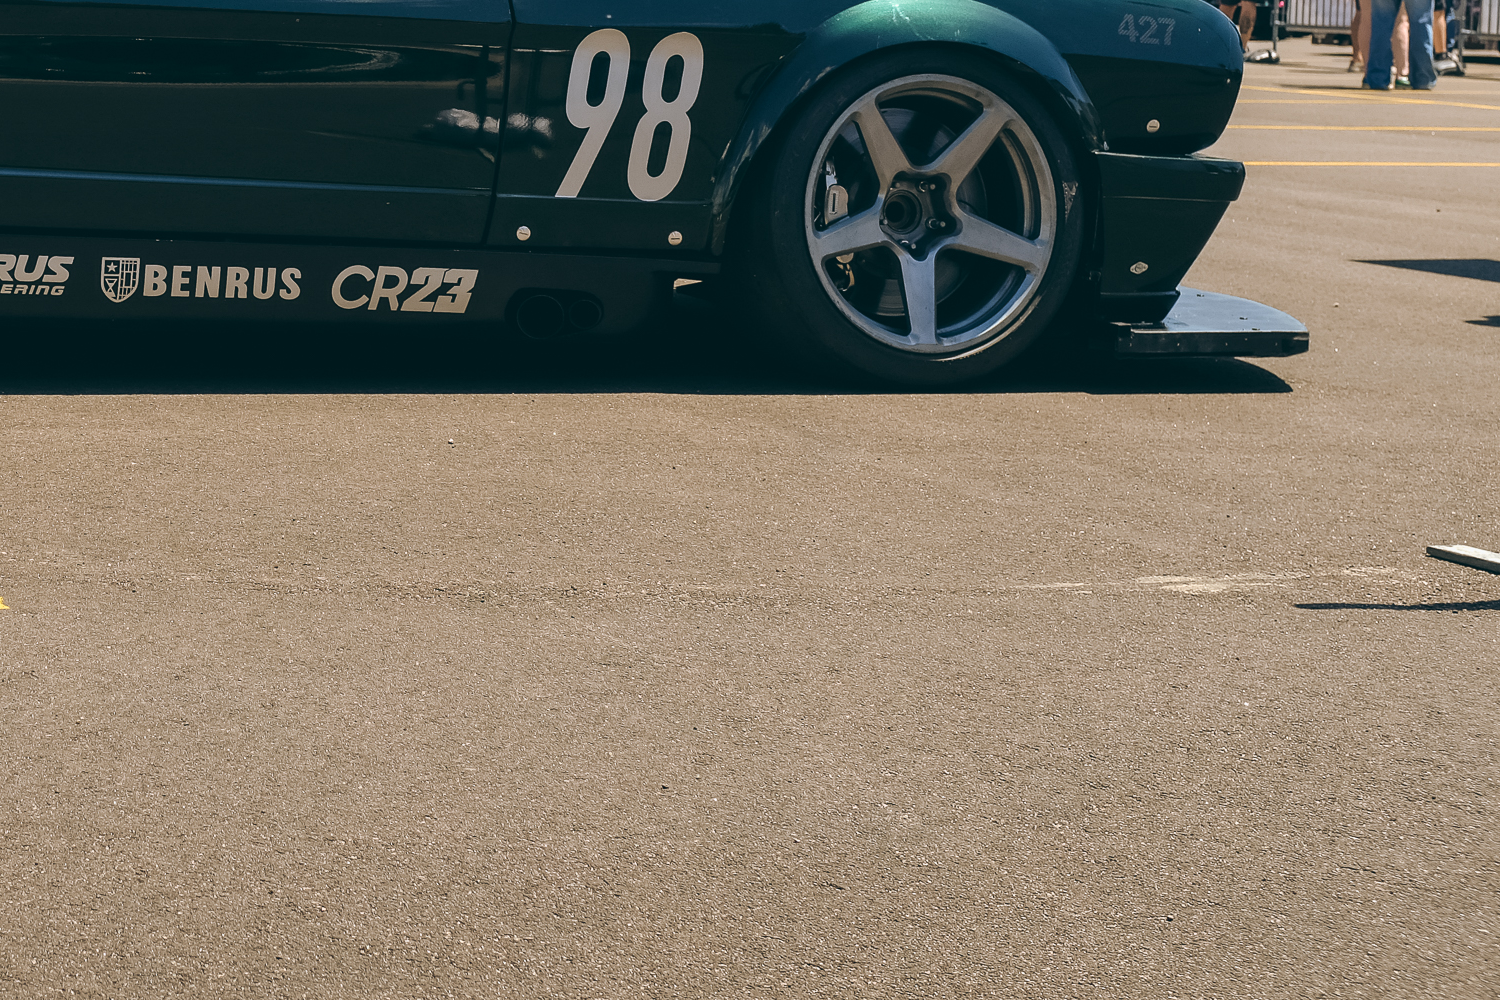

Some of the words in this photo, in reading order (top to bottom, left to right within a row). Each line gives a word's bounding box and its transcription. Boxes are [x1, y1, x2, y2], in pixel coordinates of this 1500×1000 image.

[1118, 13, 1176, 46] 427
[555, 28, 704, 202] 98
[142, 264, 302, 301] BENRUS
[331, 264, 479, 314] CR23
